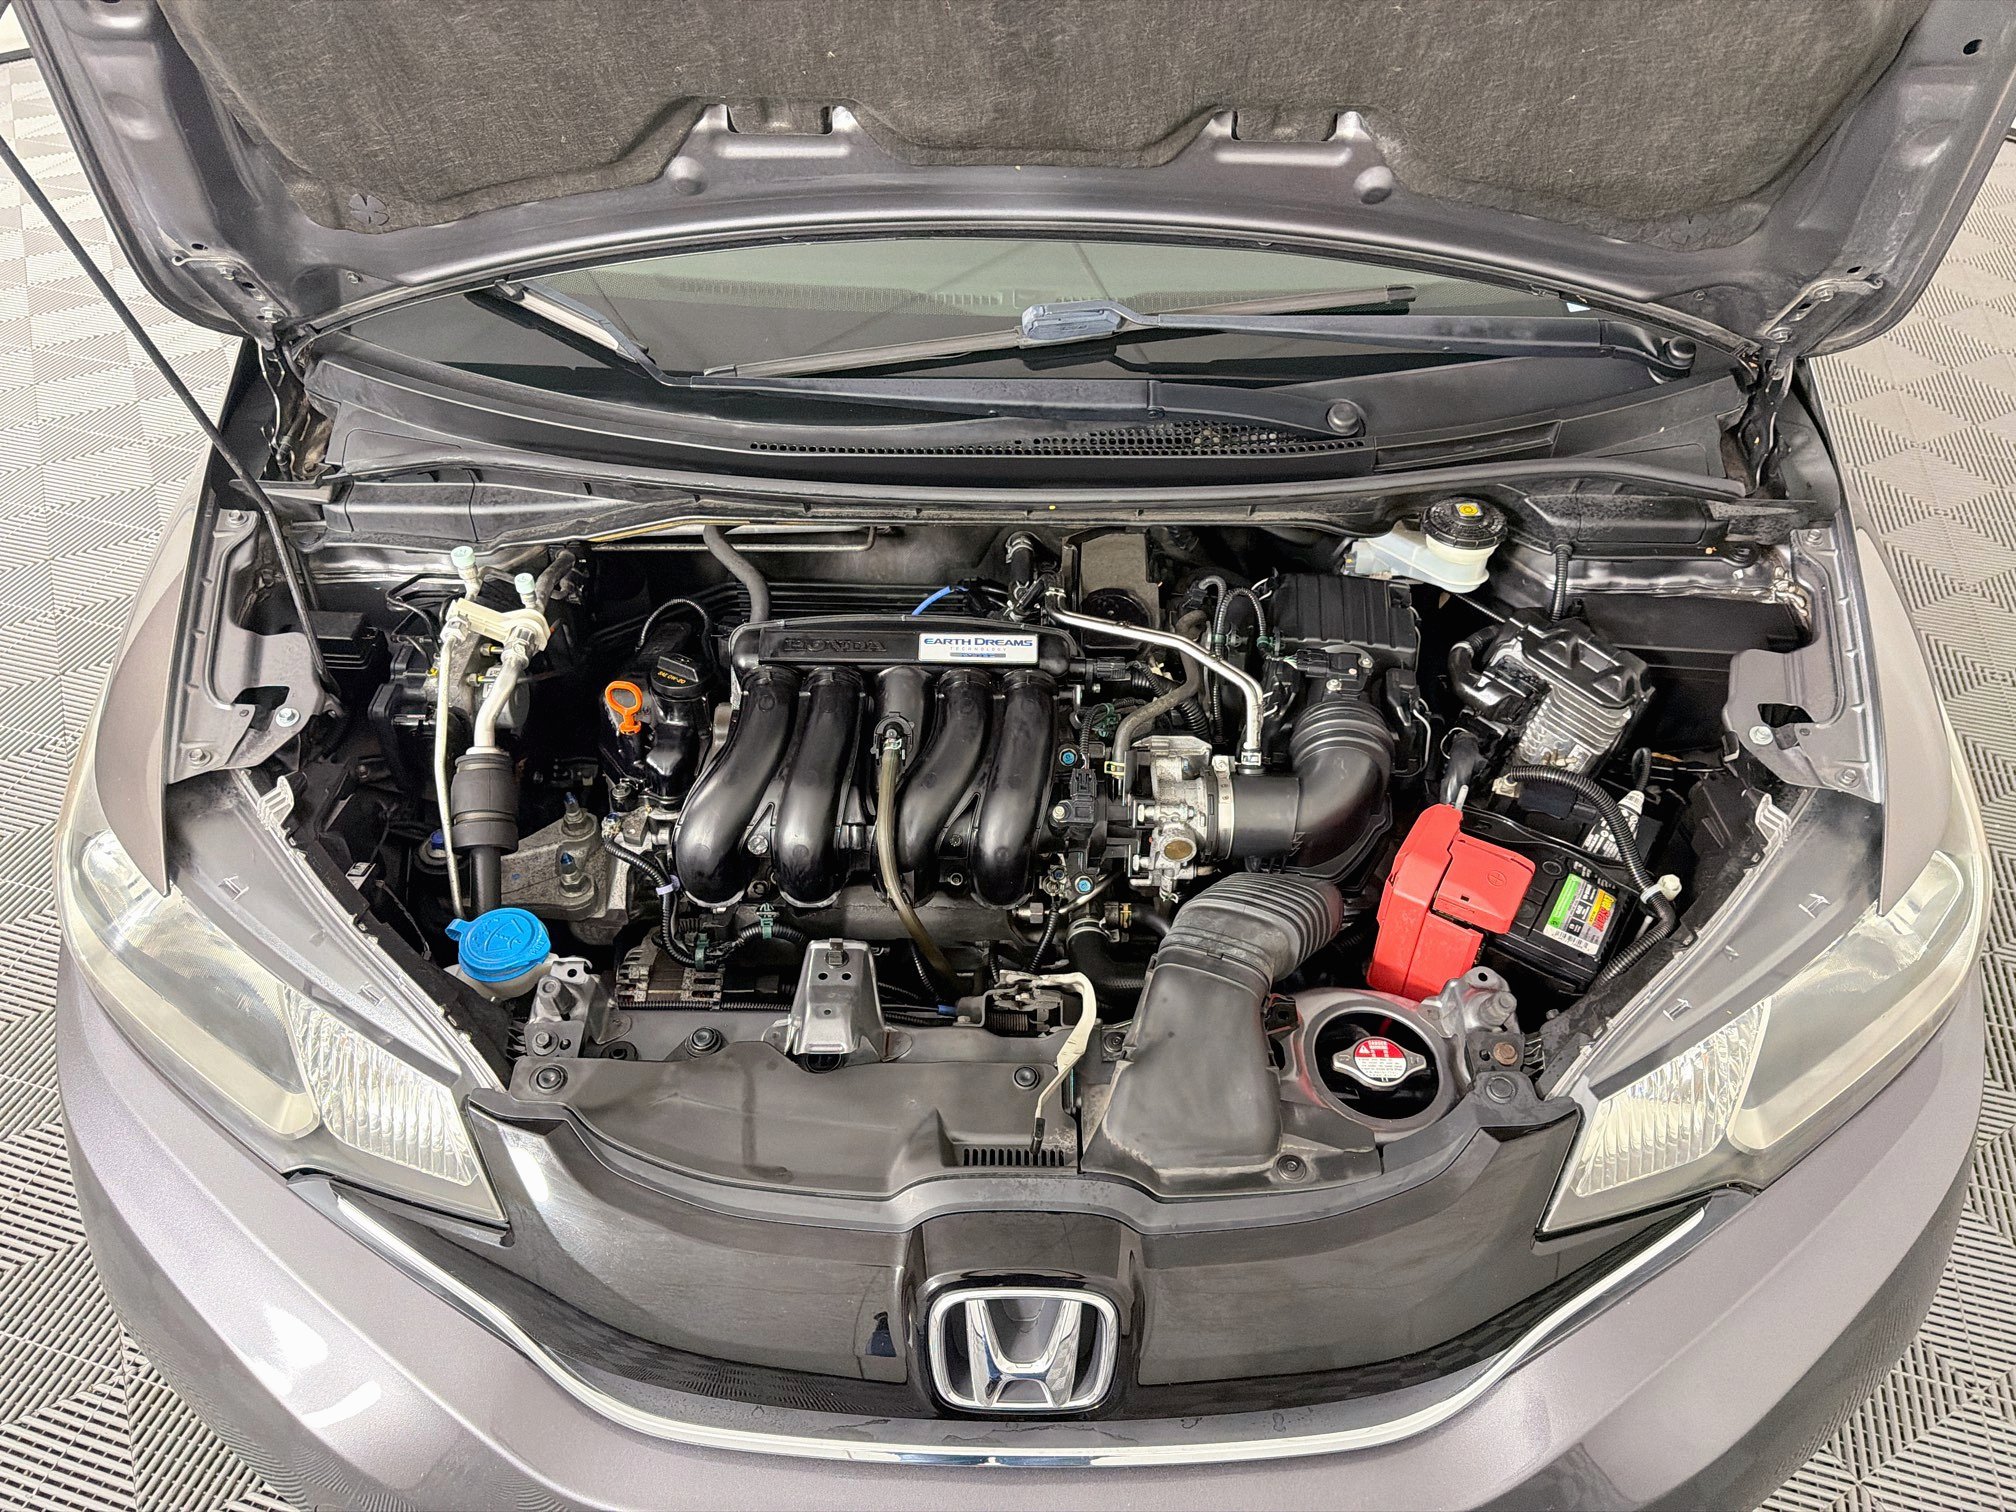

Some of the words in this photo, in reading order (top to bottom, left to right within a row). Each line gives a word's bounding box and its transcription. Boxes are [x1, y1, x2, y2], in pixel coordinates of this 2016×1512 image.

[784, 638, 887, 652] HONDA
[924, 638, 971, 646] EARTH
[974, 637, 1033, 647] DREAMS
